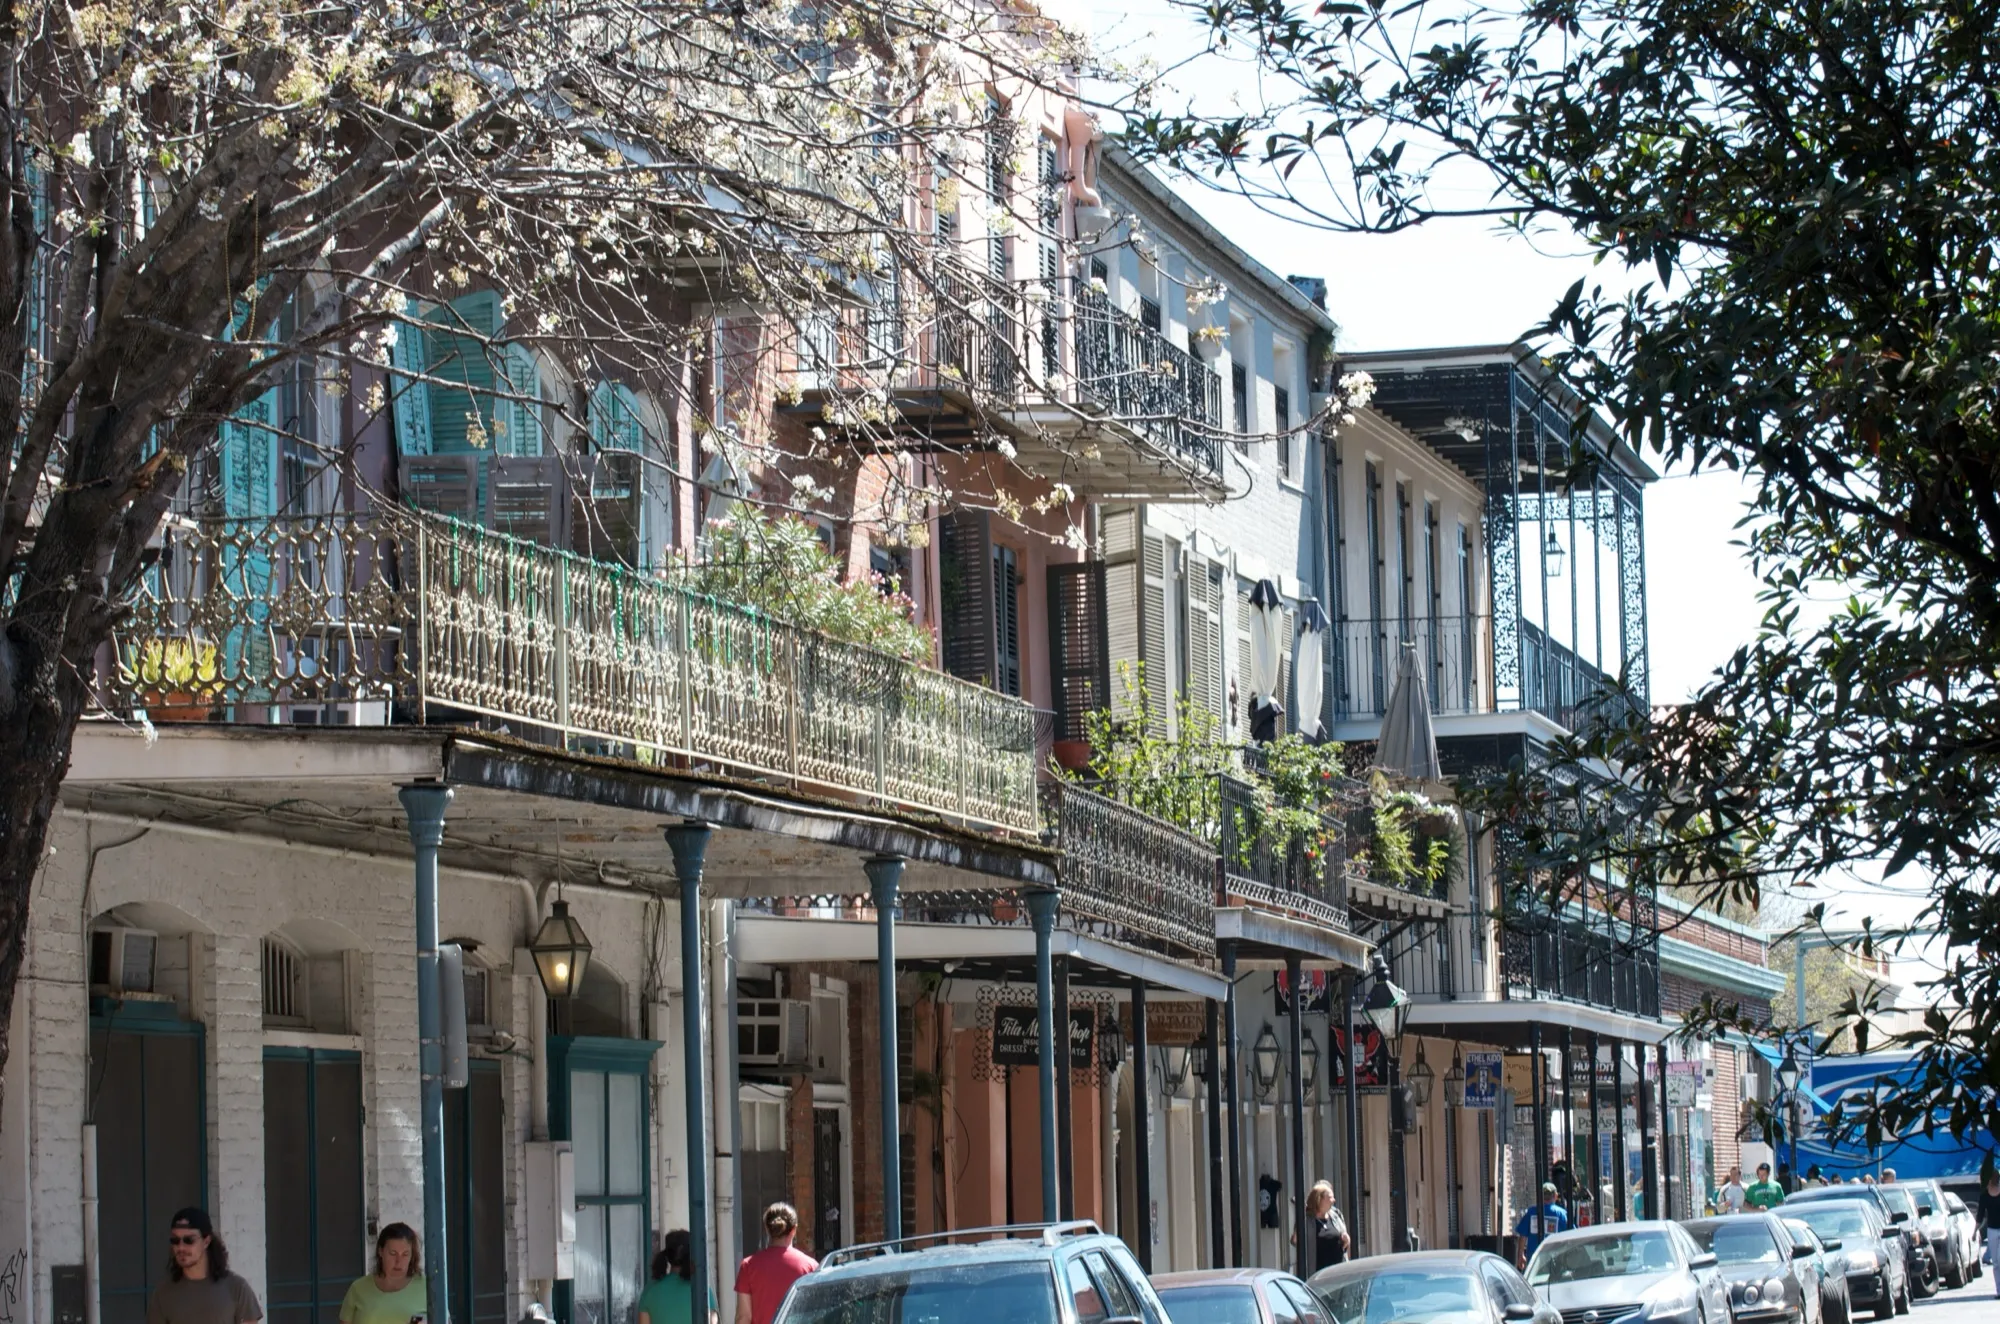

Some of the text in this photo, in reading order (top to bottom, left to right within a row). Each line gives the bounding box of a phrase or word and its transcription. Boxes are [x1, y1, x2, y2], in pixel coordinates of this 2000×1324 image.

[1466, 1054, 1501, 1063] ETHEL KIDD
[1479, 1069, 1488, 1096] RENT
